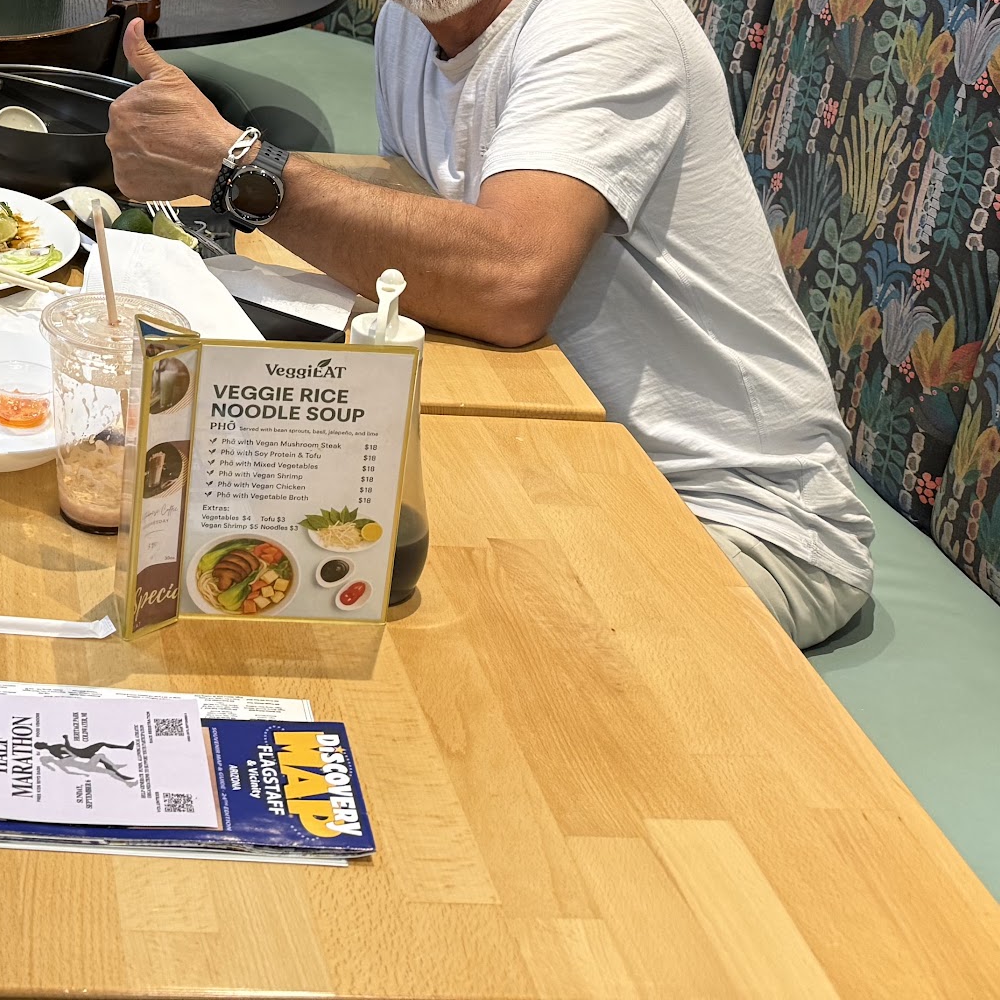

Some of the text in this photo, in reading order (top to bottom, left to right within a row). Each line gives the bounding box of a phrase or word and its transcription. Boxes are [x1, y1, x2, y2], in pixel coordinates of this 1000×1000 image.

[266, 363, 346, 379] VeggiEAT
[213, 384, 349, 404] VEGGIE RICE
[211, 403, 365, 423] NOODLE SOUP
[234, 481, 250, 490] with
[251, 482, 274, 492] Vegan
[276, 482, 306, 491] Chicken
[223, 522, 248, 530] Shrimp
[290, 523, 300, 531] $3
[11, 716, 34, 798] MARATHON
[229, 765, 242, 791] ARIZONA
[248, 768, 261, 799] Vicinity
[257, 745, 285, 816] FLAGSTAFF
[273, 731, 343, 838] MAP
